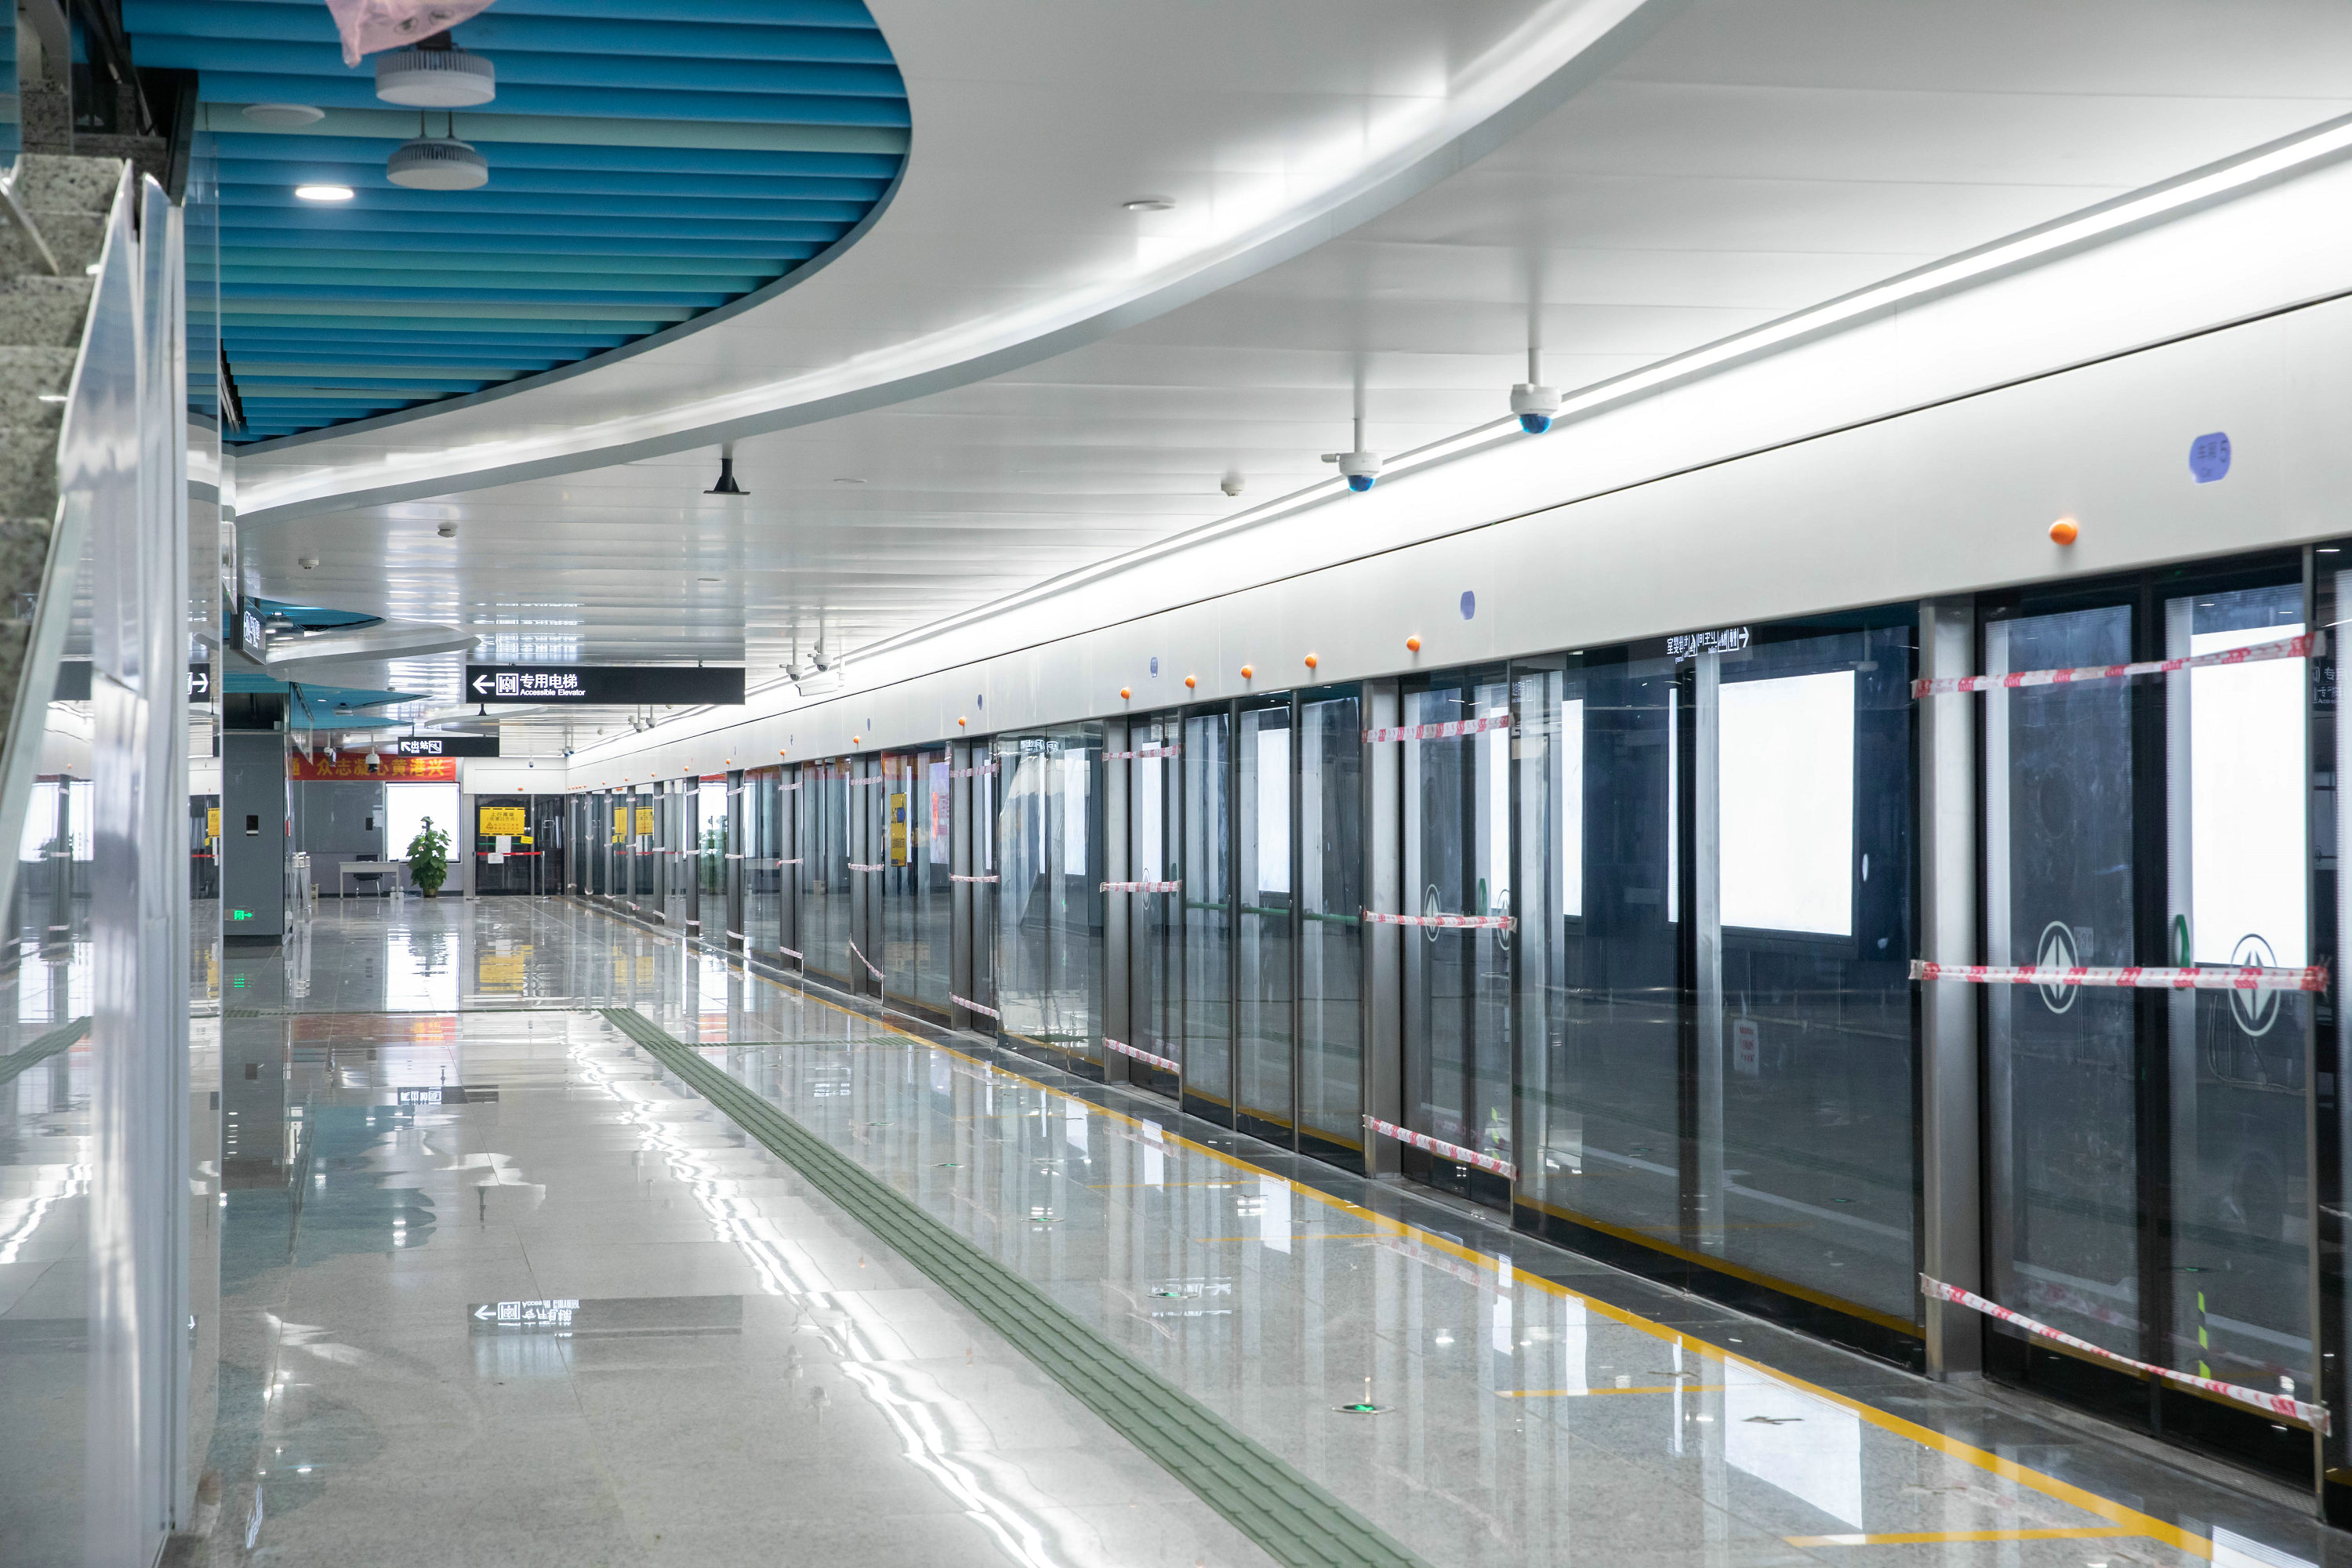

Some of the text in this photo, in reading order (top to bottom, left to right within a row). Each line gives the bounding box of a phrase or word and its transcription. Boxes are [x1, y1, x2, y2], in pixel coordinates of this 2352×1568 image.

[520, 673, 578, 689] 专用电梯
[411, 740, 429, 750] 出站
